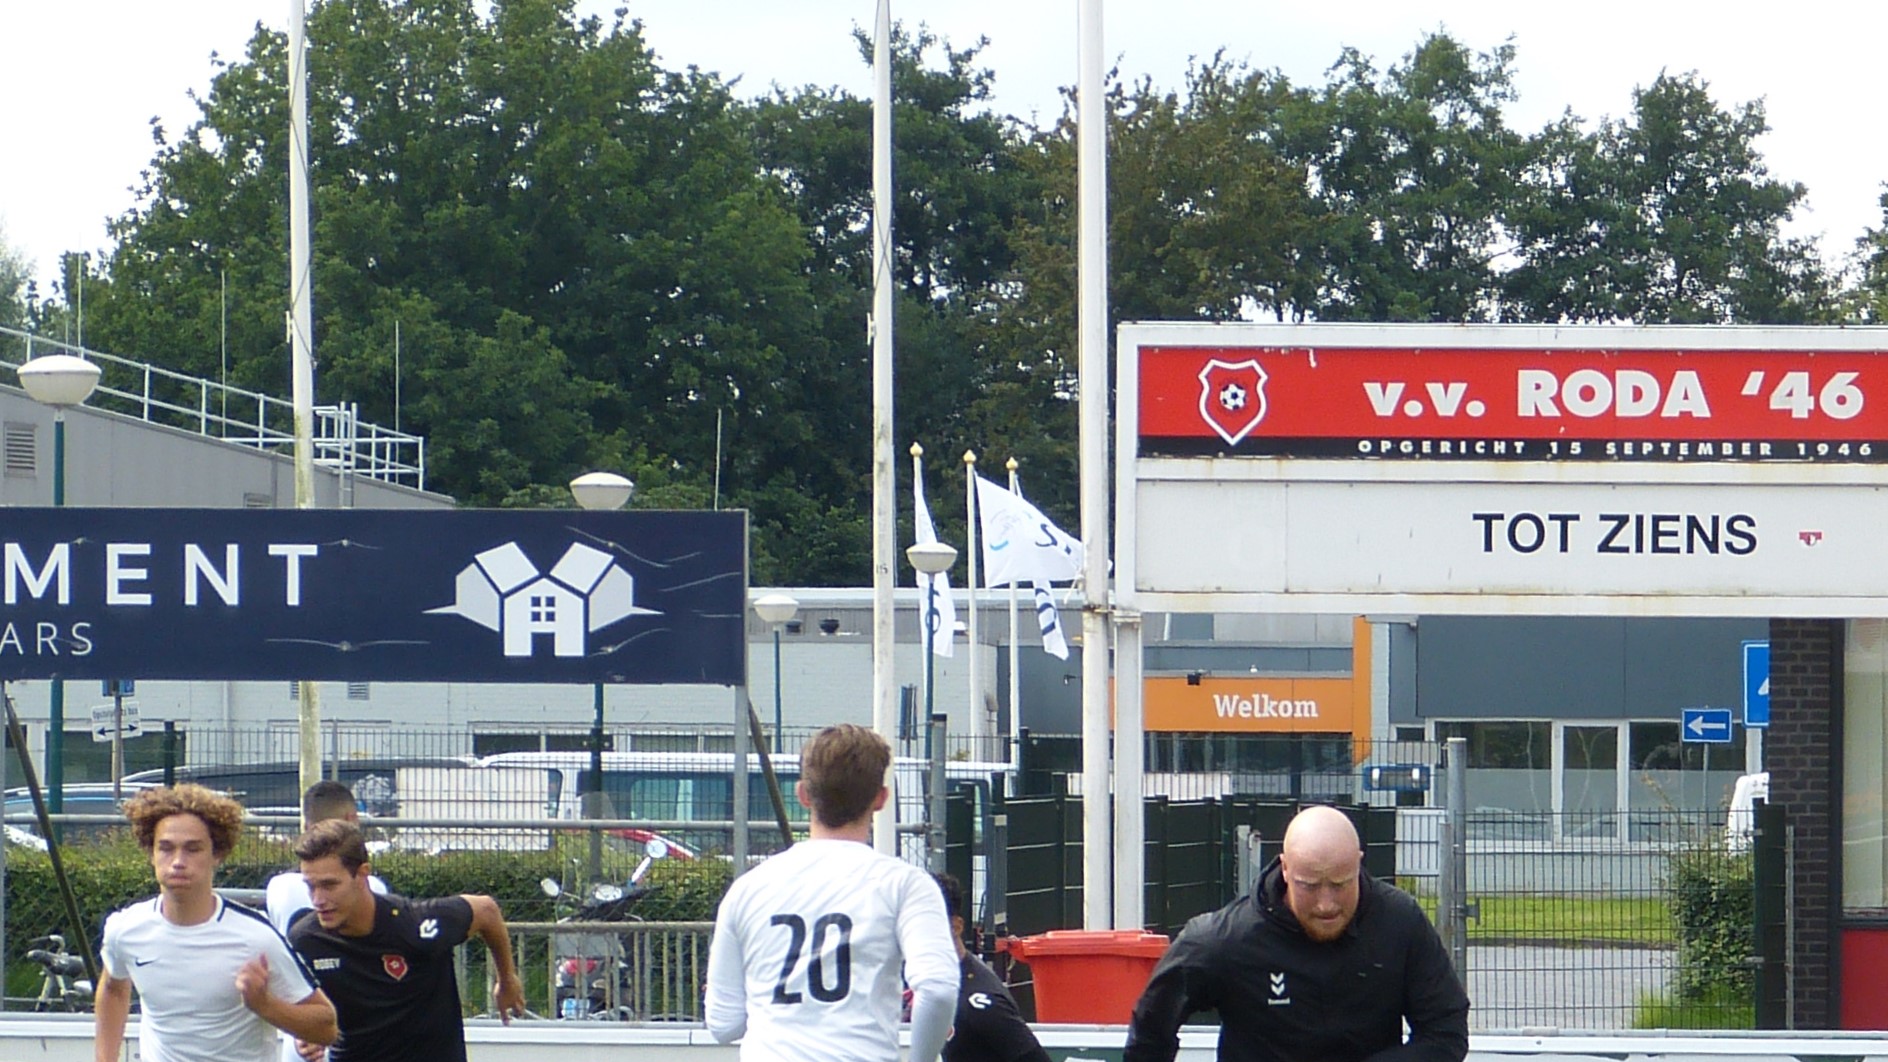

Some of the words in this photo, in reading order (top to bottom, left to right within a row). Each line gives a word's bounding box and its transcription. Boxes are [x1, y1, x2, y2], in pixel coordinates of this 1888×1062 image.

[1363, 382, 1486, 417] v.v.
[1516, 369, 1711, 418] RODA
[1358, 440, 1525, 454] OPGERICHT
[1550, 442, 1582, 455] 15
[1605, 442, 1772, 456] SEPTEMBER
[1797, 443, 1872, 457] 1946
[1472, 513, 1580, 553] TOT
[1597, 514, 1758, 555] ZIENS
[1213, 693, 1319, 718] Welkom
[771, 912, 853, 1004] 20
